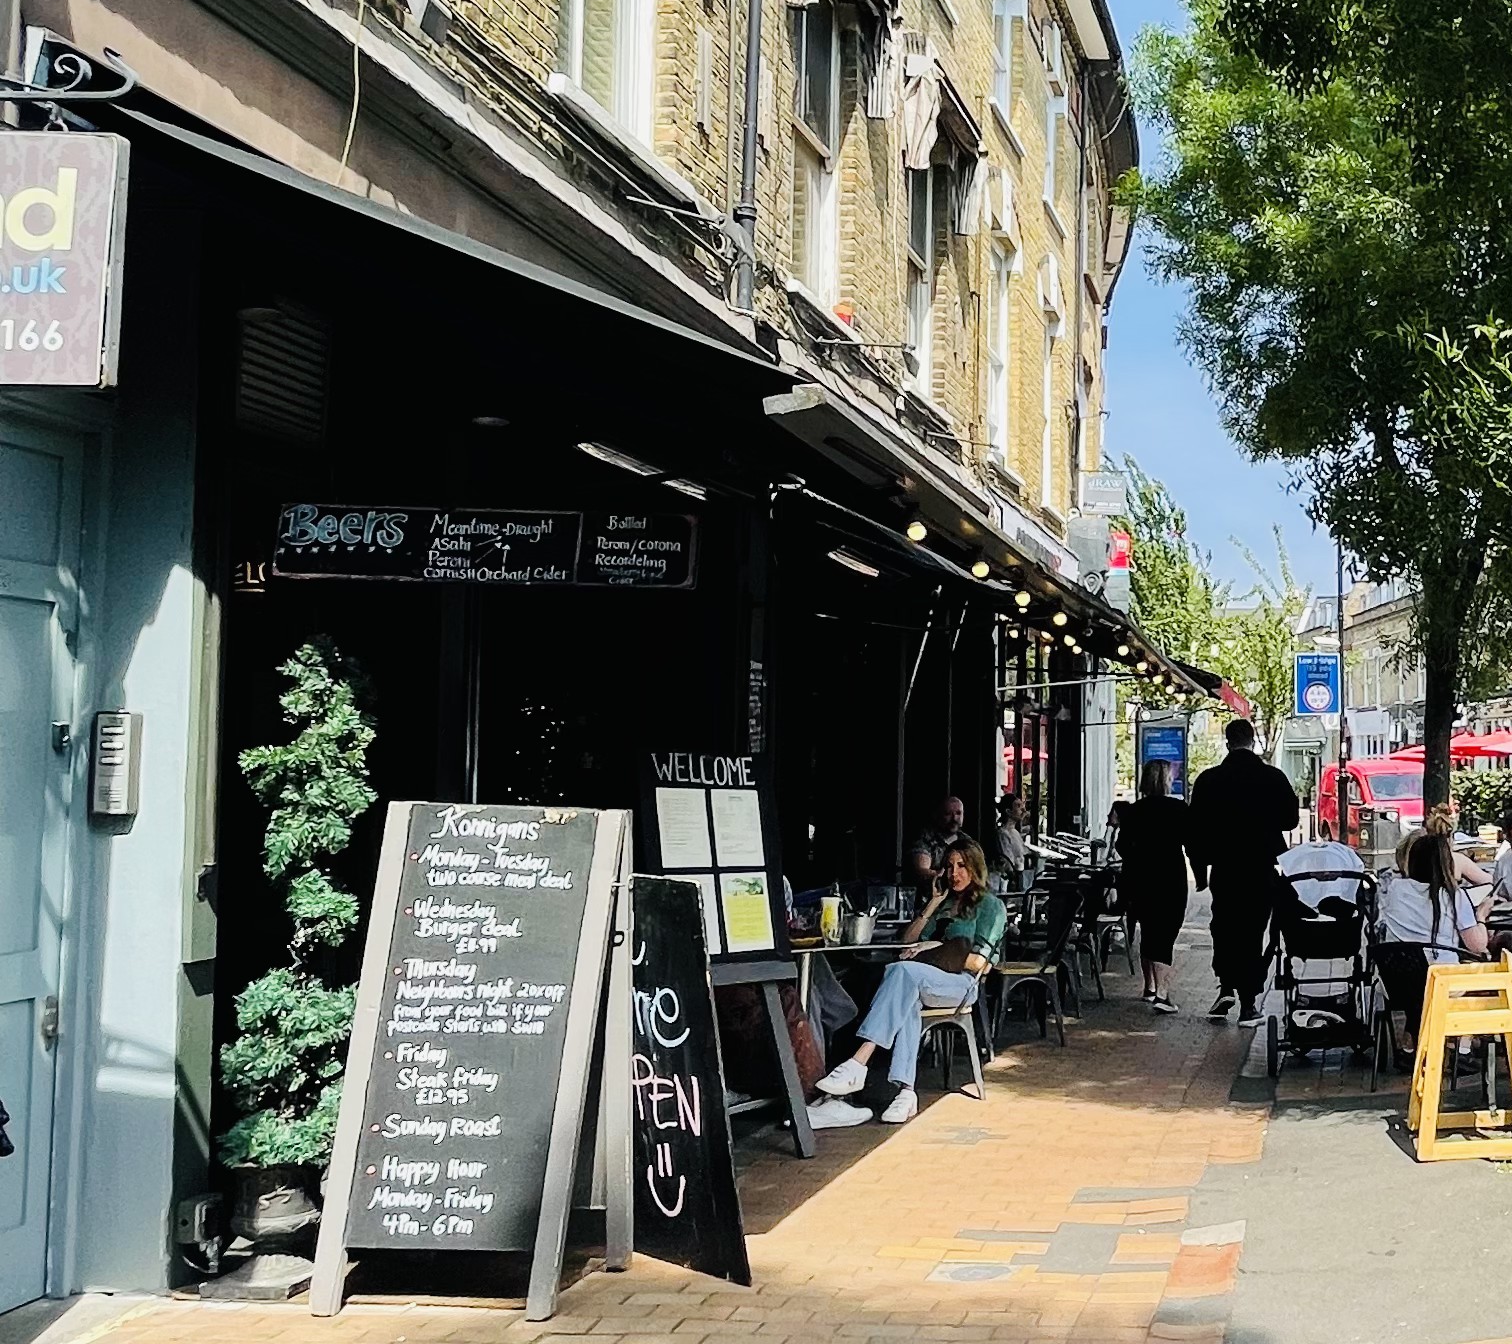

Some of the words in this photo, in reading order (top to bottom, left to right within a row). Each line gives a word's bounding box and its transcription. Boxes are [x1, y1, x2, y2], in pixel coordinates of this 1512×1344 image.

[0, 167, 78, 251] d
[0, 257, 67, 294] .uk
[281, 504, 408, 547] Beers
[430, 513, 499, 535] Meantime
[651, 752, 756, 787] WELCOME
[413, 895, 497, 924] Wednesday
[413, 917, 479, 943] Burger
[402, 958, 478, 984] Thursday
[395, 1041, 448, 1068] Friday
[395, 1066, 449, 1090] Steak
[632, 1053, 701, 1137] PEN
[381, 1113, 448, 1145] Sunday
[381, 1154, 441, 1187] Happy
